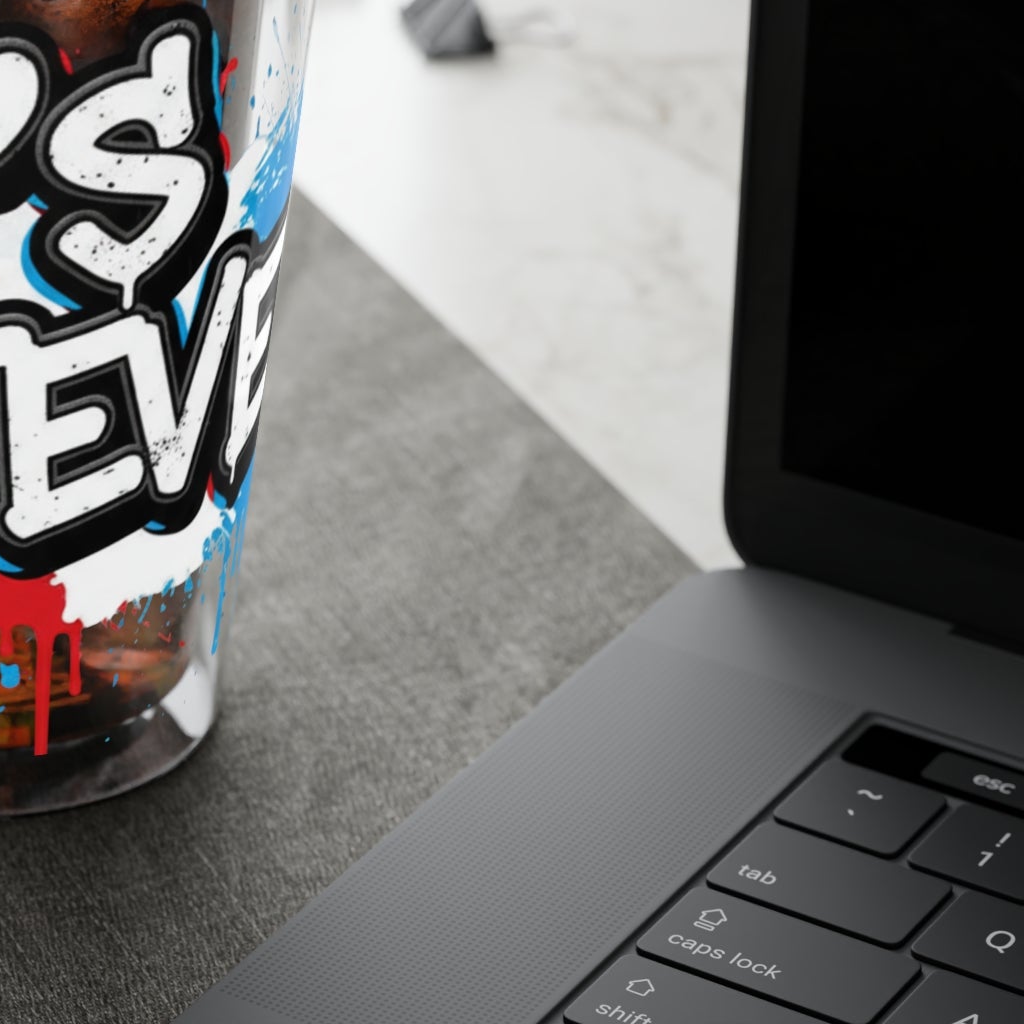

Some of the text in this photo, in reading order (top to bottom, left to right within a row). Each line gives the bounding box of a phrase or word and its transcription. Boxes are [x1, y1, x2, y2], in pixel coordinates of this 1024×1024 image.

[972, 773, 1017, 795] esc
[977, 850, 994, 867] 1
[737, 864, 777, 885] tab
[985, 930, 1016, 954] Q
[667, 933, 782, 980] caps lock
[594, 1002, 653, 1024] shift
